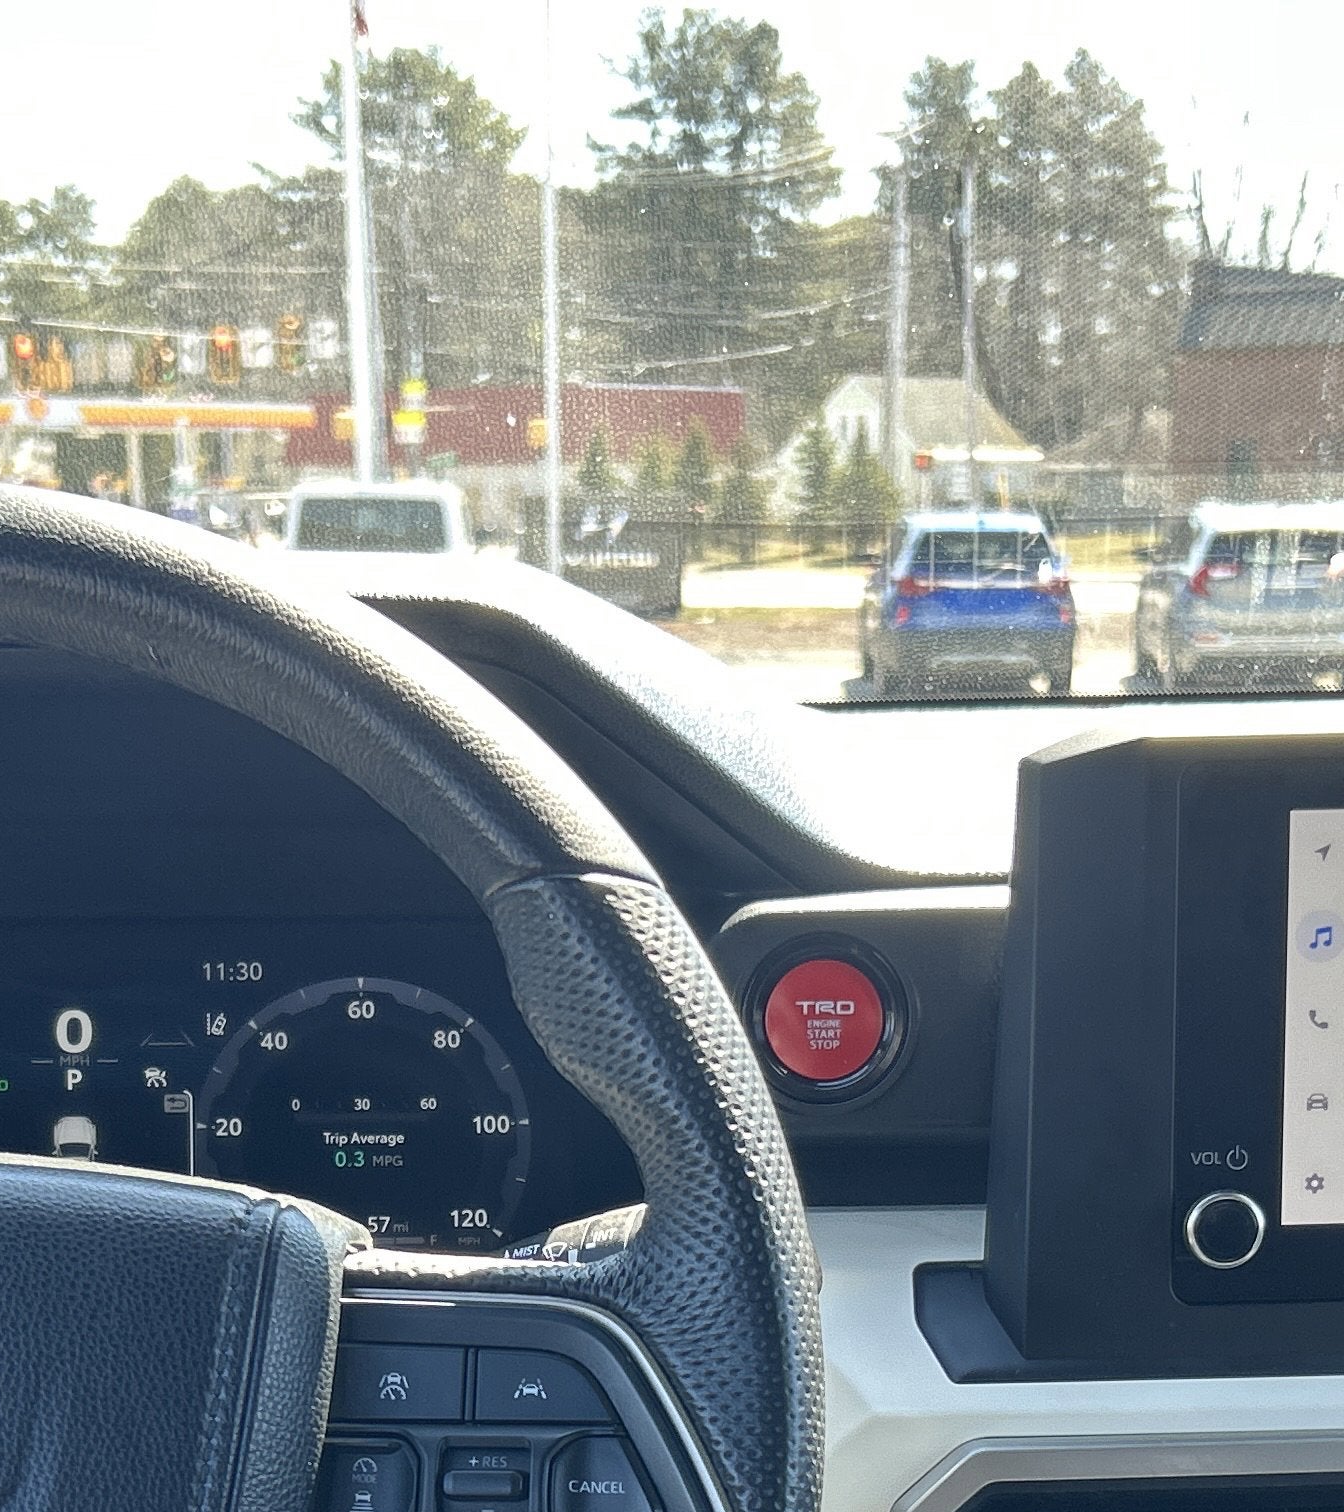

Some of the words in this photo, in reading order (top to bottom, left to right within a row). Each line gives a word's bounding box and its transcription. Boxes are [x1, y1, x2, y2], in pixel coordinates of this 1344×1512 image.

[203, 962, 263, 981] 11:30
[348, 1001, 375, 1019] 60
[795, 1001, 855, 1016] TRD
[807, 1019, 841, 1028] ENGINE
[56, 1010, 93, 1053] 0
[807, 1029, 842, 1039] START
[260, 1032, 288, 1050] 40
[434, 1030, 461, 1049] 80
[809, 1040, 840, 1050] STOP
[59, 1056, 90, 1066] MPH
[67, 1069, 82, 1091] P
[292, 1099, 300, 1111] 0
[354, 1099, 371, 1111] 30
[420, 1098, 437, 1110] 60
[215, 1118, 243, 1137] 20
[473, 1116, 510, 1134] 100
[323, 1132, 348, 1146] Trip
[351, 1132, 405, 1147] Average
[335, 1152, 365, 1168] 0.3
[372, 1155, 404, 1167] MPG
[1190, 1152, 1221, 1165] VOL
[451, 1209, 488, 1228] 120
[393, 1222, 409, 1232] mi
[513, 1244, 541, 1259] MIST
[352, 1474, 378, 1483] MODE
[568, 1480, 626, 1495] CANCEL
